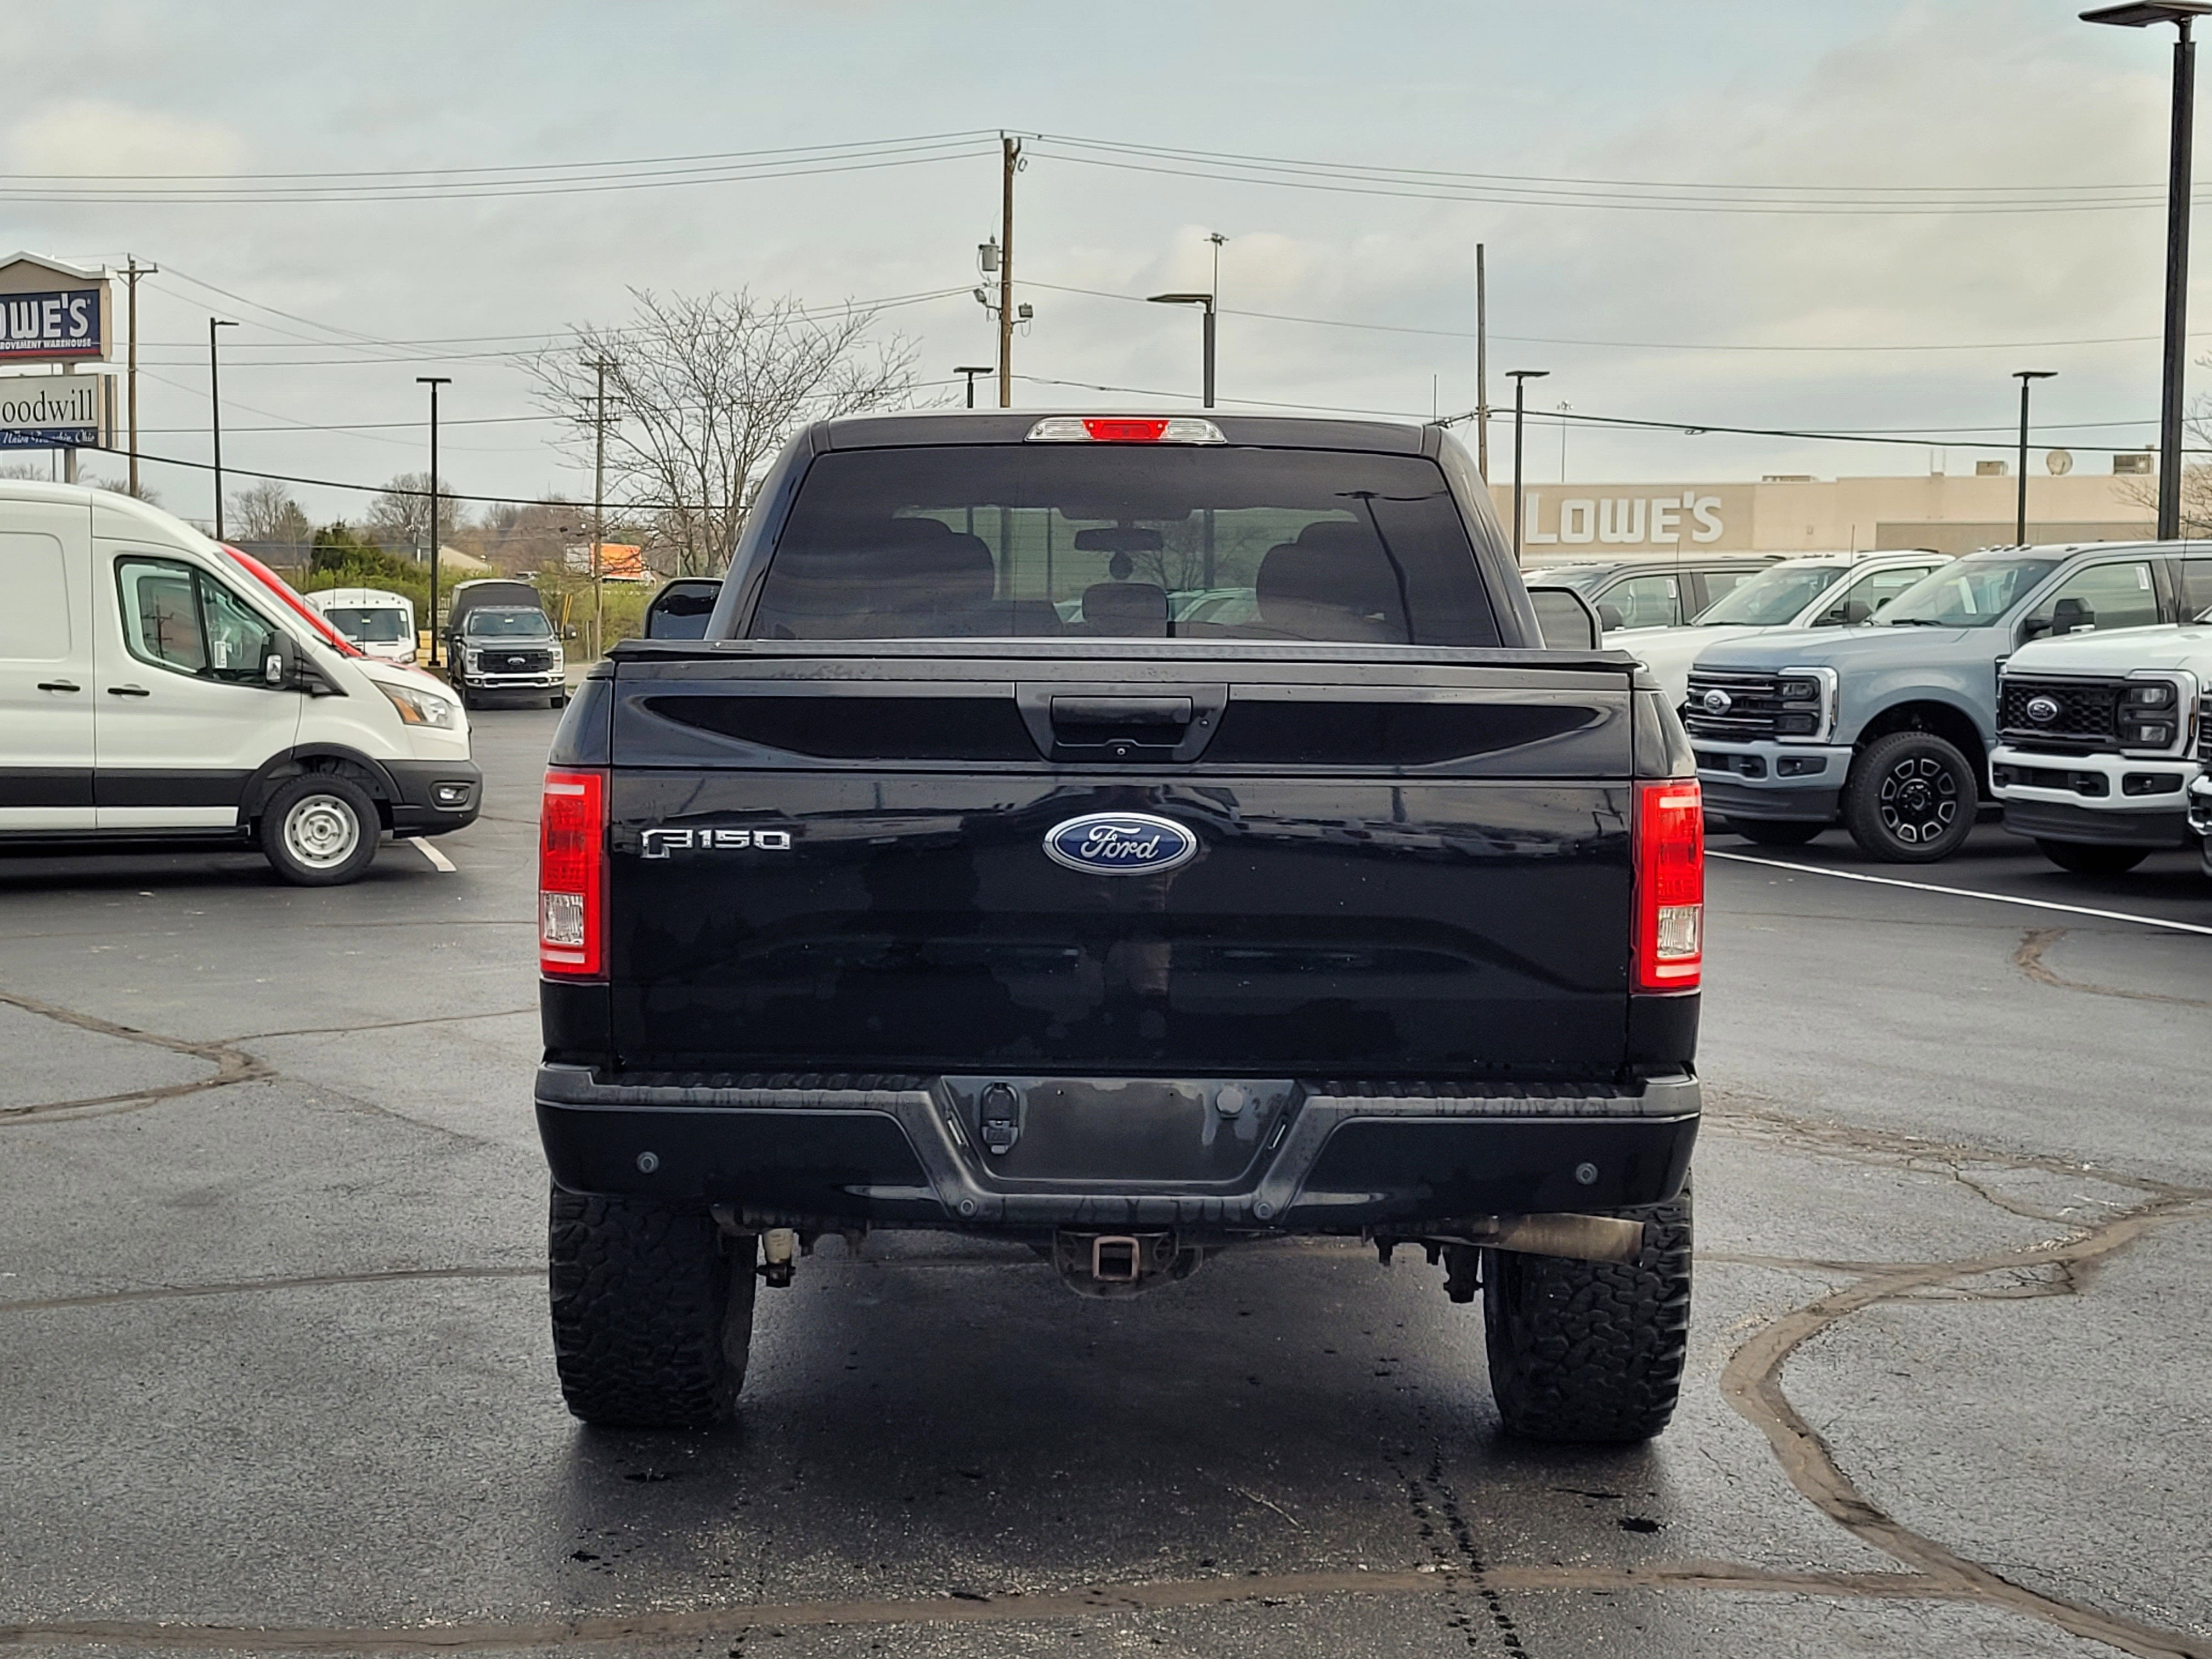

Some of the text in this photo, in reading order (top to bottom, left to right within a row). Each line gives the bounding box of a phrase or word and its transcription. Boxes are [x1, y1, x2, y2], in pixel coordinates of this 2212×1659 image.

[0, 293, 89, 340] WE'S
[44, 338, 92, 348] WAREHOUSE
[0, 388, 94, 423] oodwill
[1525, 491, 1724, 544] LOWE'S
[1080, 825, 1160, 859] Ford
